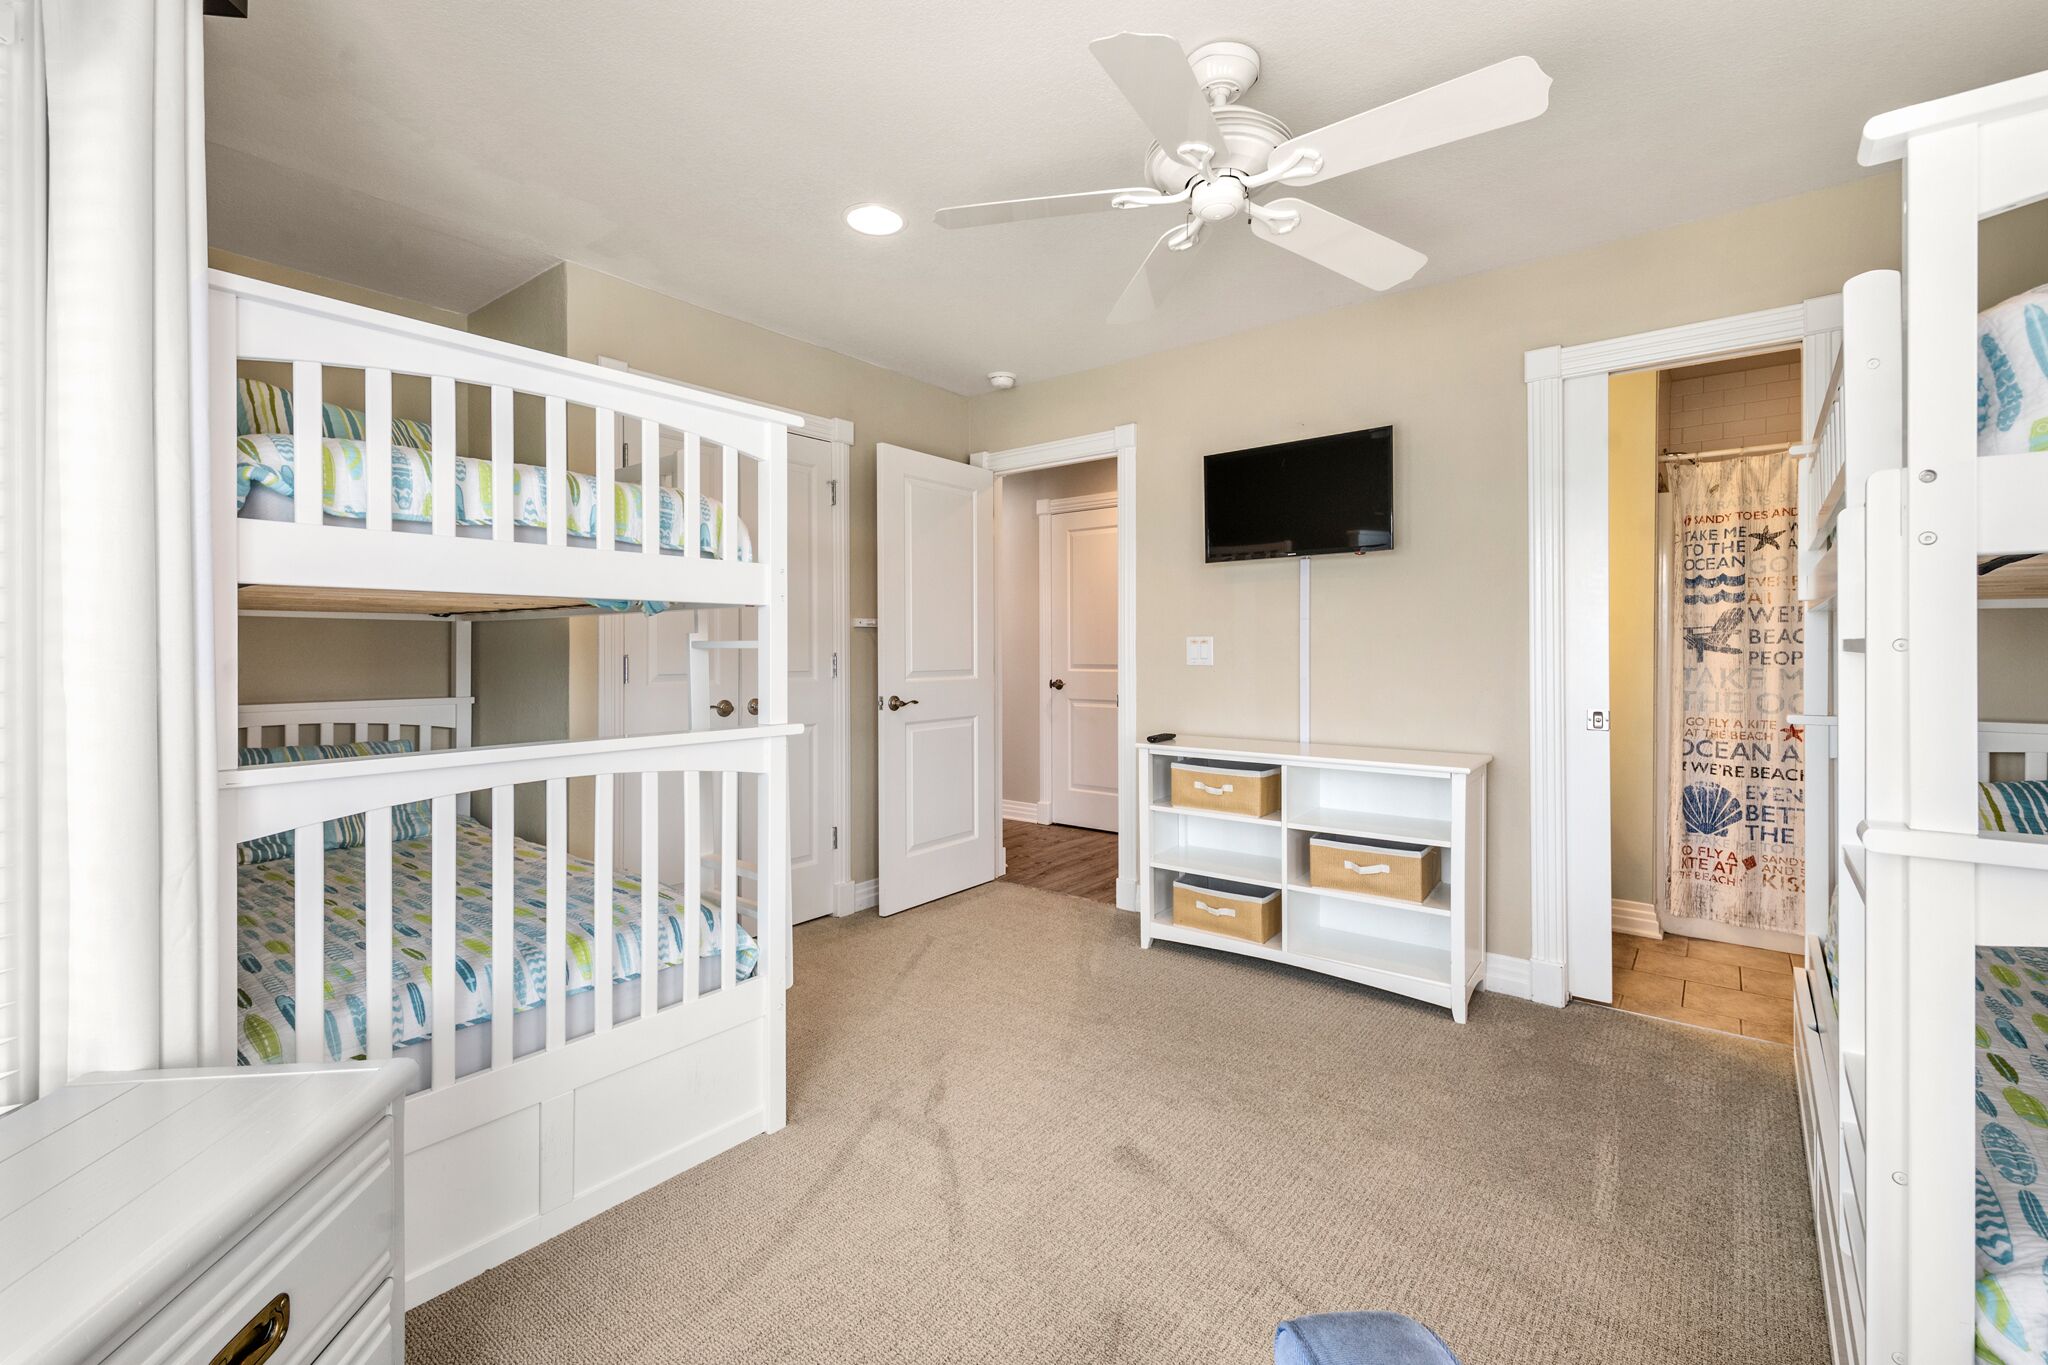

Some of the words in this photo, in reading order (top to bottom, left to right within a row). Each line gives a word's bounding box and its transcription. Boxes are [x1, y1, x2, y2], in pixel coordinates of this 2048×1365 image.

[1694, 512, 1732, 525] SANDY
[1737, 509, 1768, 520] TOES
[1771, 507, 1798, 518] AND
[1684, 529, 1718, 542] TAKE
[1724, 526, 1747, 539] ME
[1684, 543, 1704, 557] TO
[1707, 540, 1746, 554] THE
[1684, 555, 1745, 571] OCEAN
[1684, 667, 1764, 690] TAKE
[1684, 691, 1744, 713] THE
[1686, 717, 1705, 726] GO
[1709, 718, 1728, 728] FLY
[1733, 720, 1744, 729] A
[1748, 719, 1777, 730] KITE
[1685, 729, 1703, 738] AT
[1705, 729, 1727, 740] THE
[1731, 731, 1773, 741] BEACH
[1683, 739, 1771, 762] OCEAN
[1691, 761, 1745, 778] WE'RE
[1745, 825, 1795, 844] THE
[1698, 846, 1723, 860] FLY
[1727, 852, 1738, 863] A
[1713, 861, 1738, 876] AT
[1761, 866, 1794, 877] AND
[1695, 871, 1736, 887] BEACH
